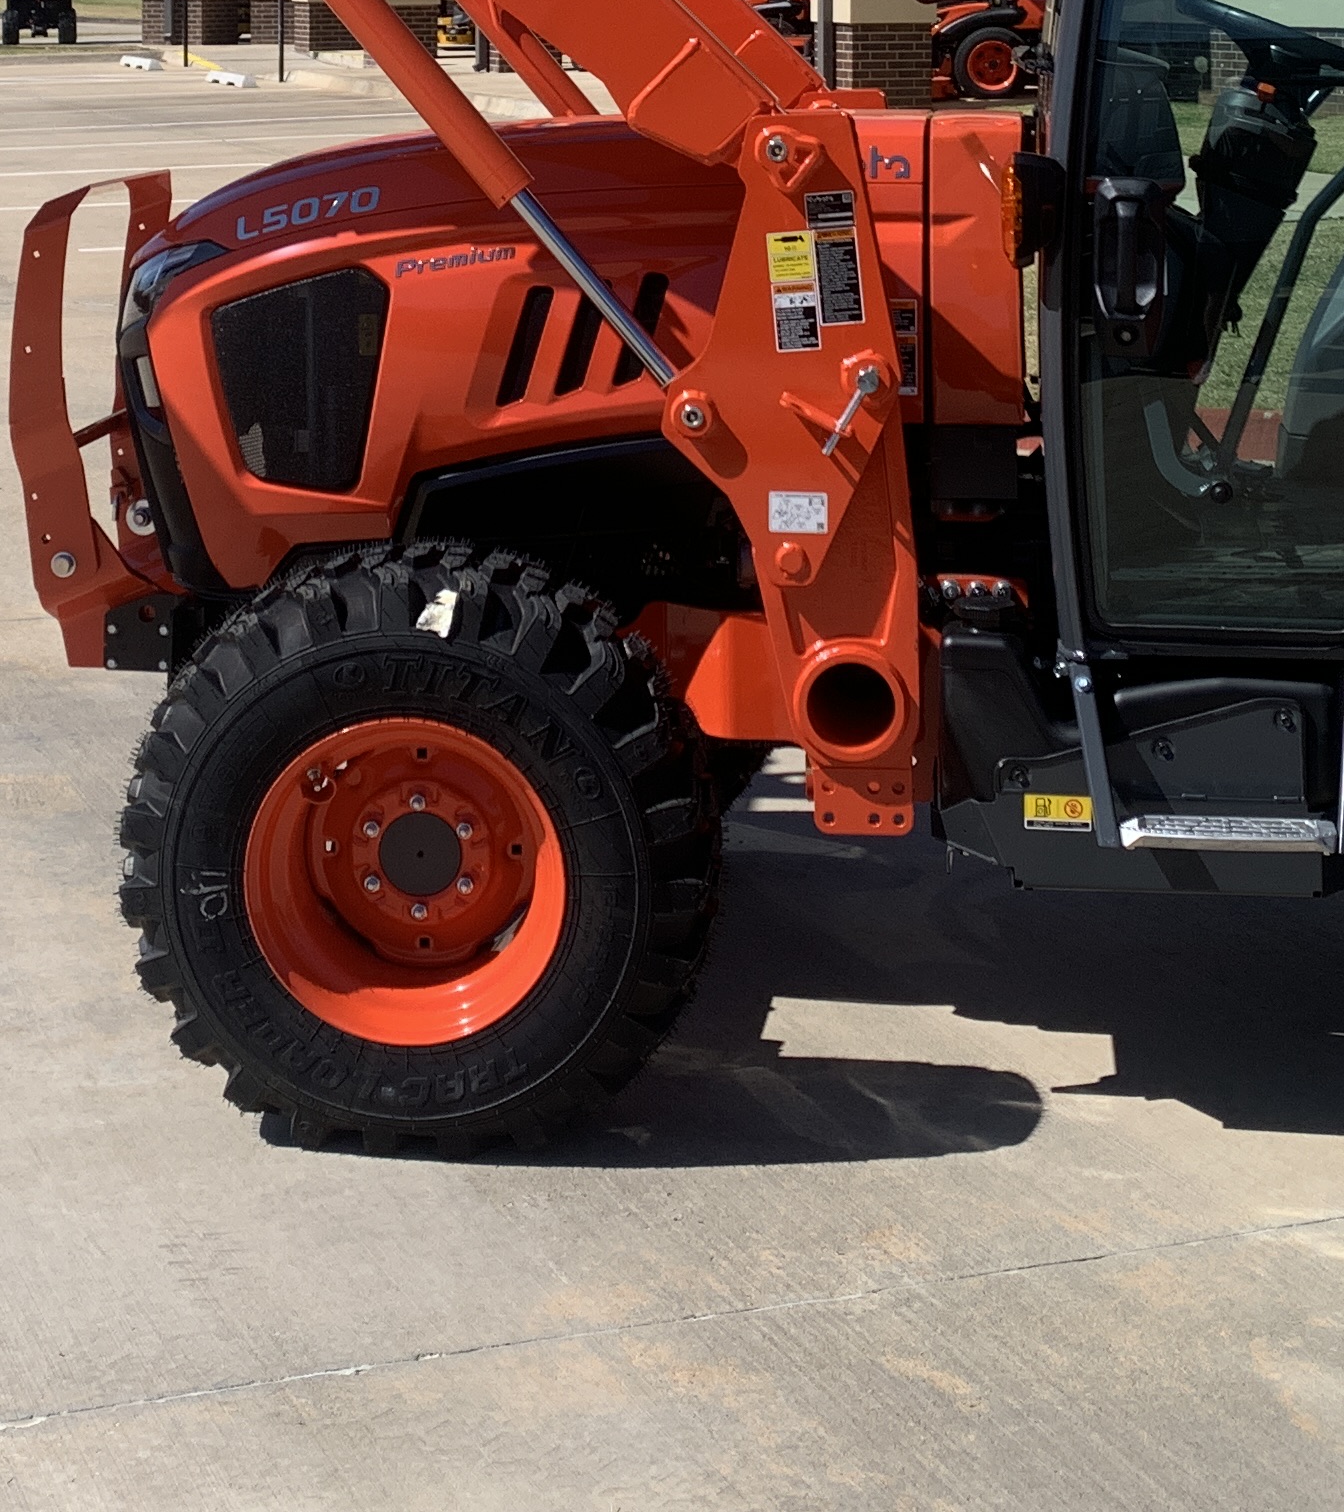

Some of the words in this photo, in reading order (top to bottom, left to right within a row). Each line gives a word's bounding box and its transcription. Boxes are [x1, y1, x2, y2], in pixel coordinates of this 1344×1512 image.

[236, 186, 380, 240] L5070
[395, 246, 516, 278] Premium
[382, 653, 576, 768] TITAN
